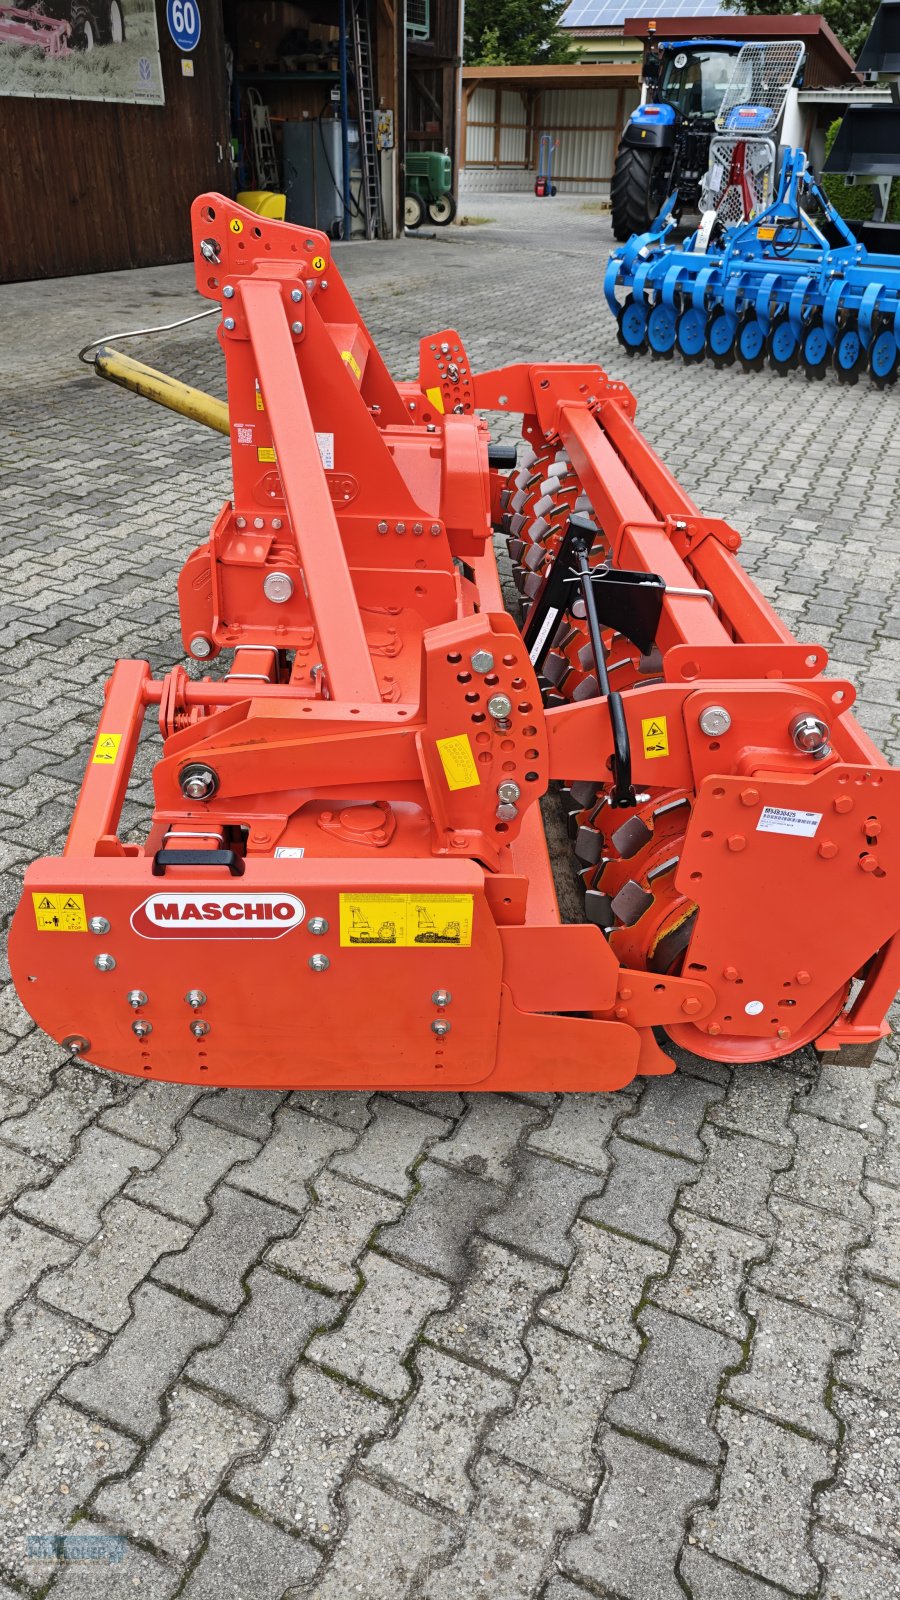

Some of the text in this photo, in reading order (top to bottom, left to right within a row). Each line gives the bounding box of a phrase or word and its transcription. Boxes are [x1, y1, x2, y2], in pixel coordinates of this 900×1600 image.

[172, 0, 195, 34] 60
[676, 56, 685, 65] 40
[153, 902, 296, 921] MASCHIO
